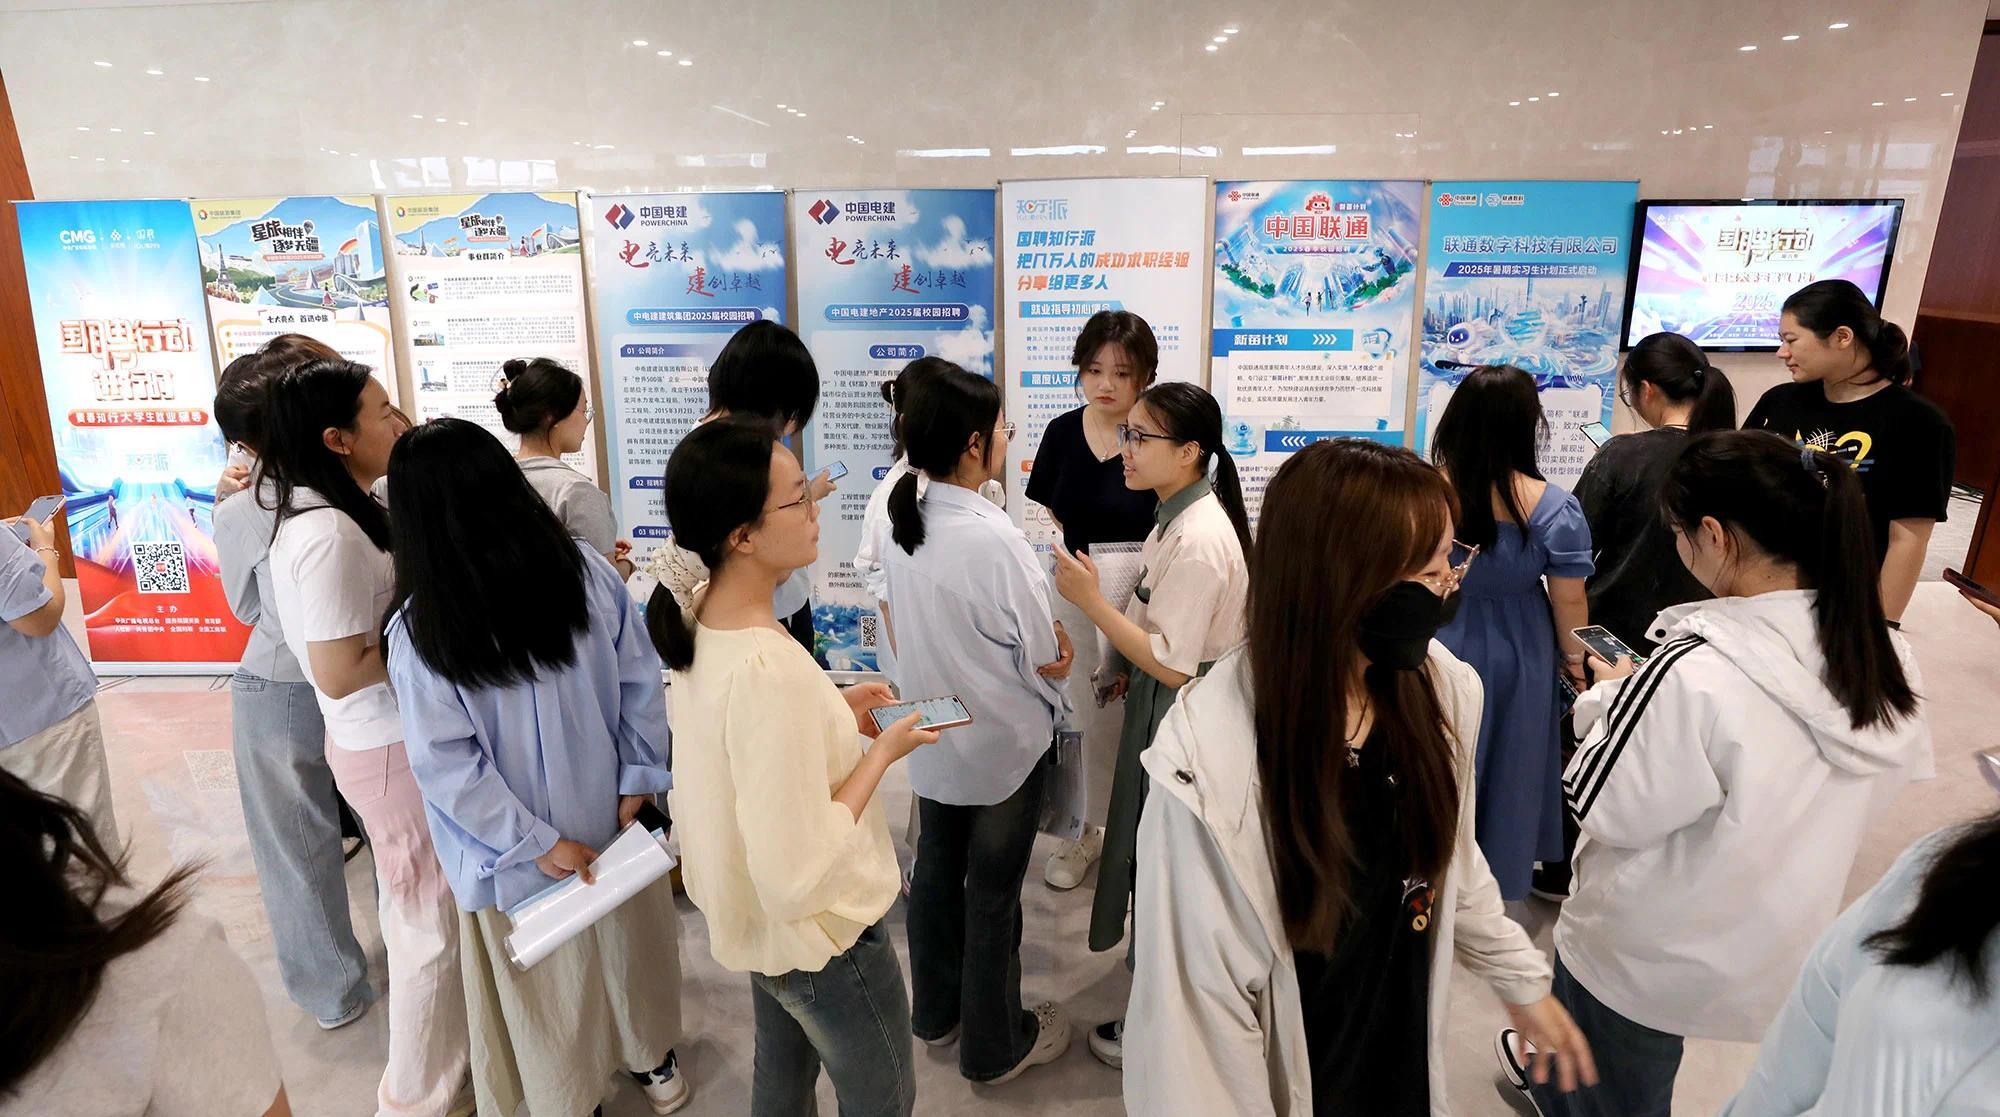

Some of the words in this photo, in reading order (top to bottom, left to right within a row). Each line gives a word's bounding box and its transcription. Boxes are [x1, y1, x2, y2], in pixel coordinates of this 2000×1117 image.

[640, 206, 688, 219] 中国电建
[845, 201, 895, 214] 中国电建
[251, 220, 304, 241] 星旅相伴
[1264, 215, 1369, 240] 中国联通
[60, 229, 97, 244] CMG
[1016, 230, 1096, 247] 国聘知行派
[1443, 236, 1618, 254] 联通数字科技有限公司
[272, 237, 320, 254] 逐梦无疆
[618, 239, 694, 268] 电亮未来
[824, 236, 901, 265] 电亮未来
[1016, 252, 1190, 269] 把几万人的成功求职经验
[1458, 264, 1598, 275] 2025年暑期实习生计划正式启动
[685, 265, 763, 298] 建创卓越
[891, 263, 967, 295] 建创卓越
[1017, 274, 1109, 291] 分享给更多人
[633, 311, 755, 322] 中电建建筑集团2025届校园招聘
[831, 306, 961, 319] 中国电建地产2025届校园招聘
[60, 317, 197, 371] 国聘行动
[1233, 334, 1289, 346] 新苗计划
[626, 347, 635, 355] 01
[638, 347, 665, 356] 公司简介
[876, 346, 919, 358] 公司简介
